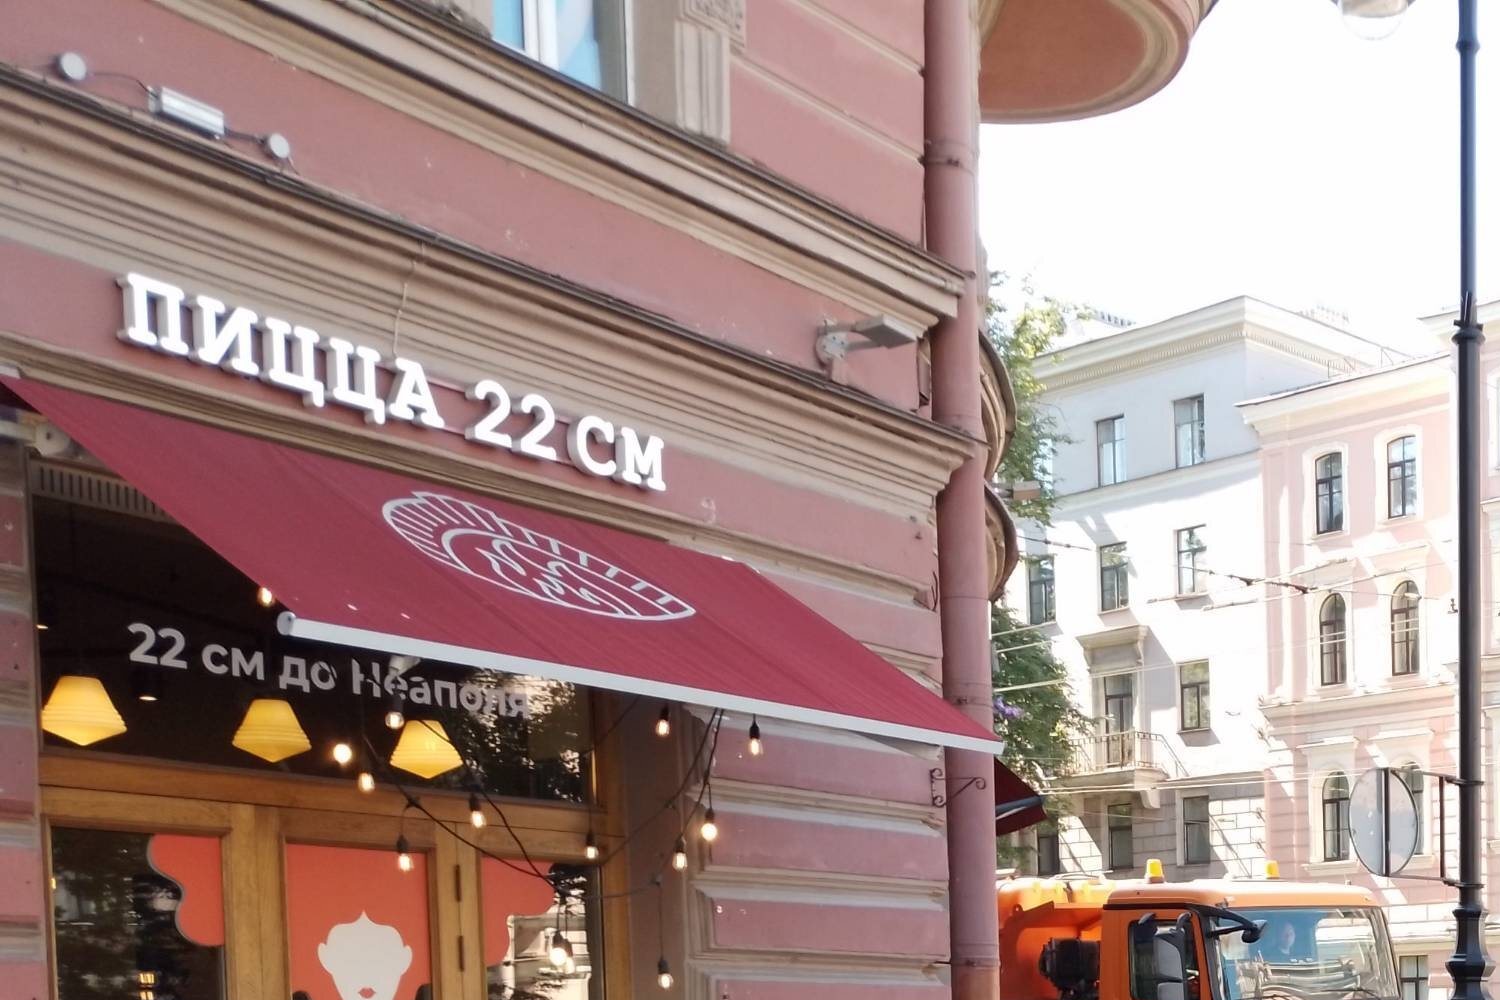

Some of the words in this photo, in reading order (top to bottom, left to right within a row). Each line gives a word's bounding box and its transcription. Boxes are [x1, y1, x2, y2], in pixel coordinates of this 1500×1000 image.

[119, 272, 445, 428] ПИЦЦА
[466, 380, 557, 461] 22
[127, 623, 188, 670] 22
[202, 643, 264, 681] см
[279, 655, 338, 693] до
[351, 658, 529, 718] Неаполя
